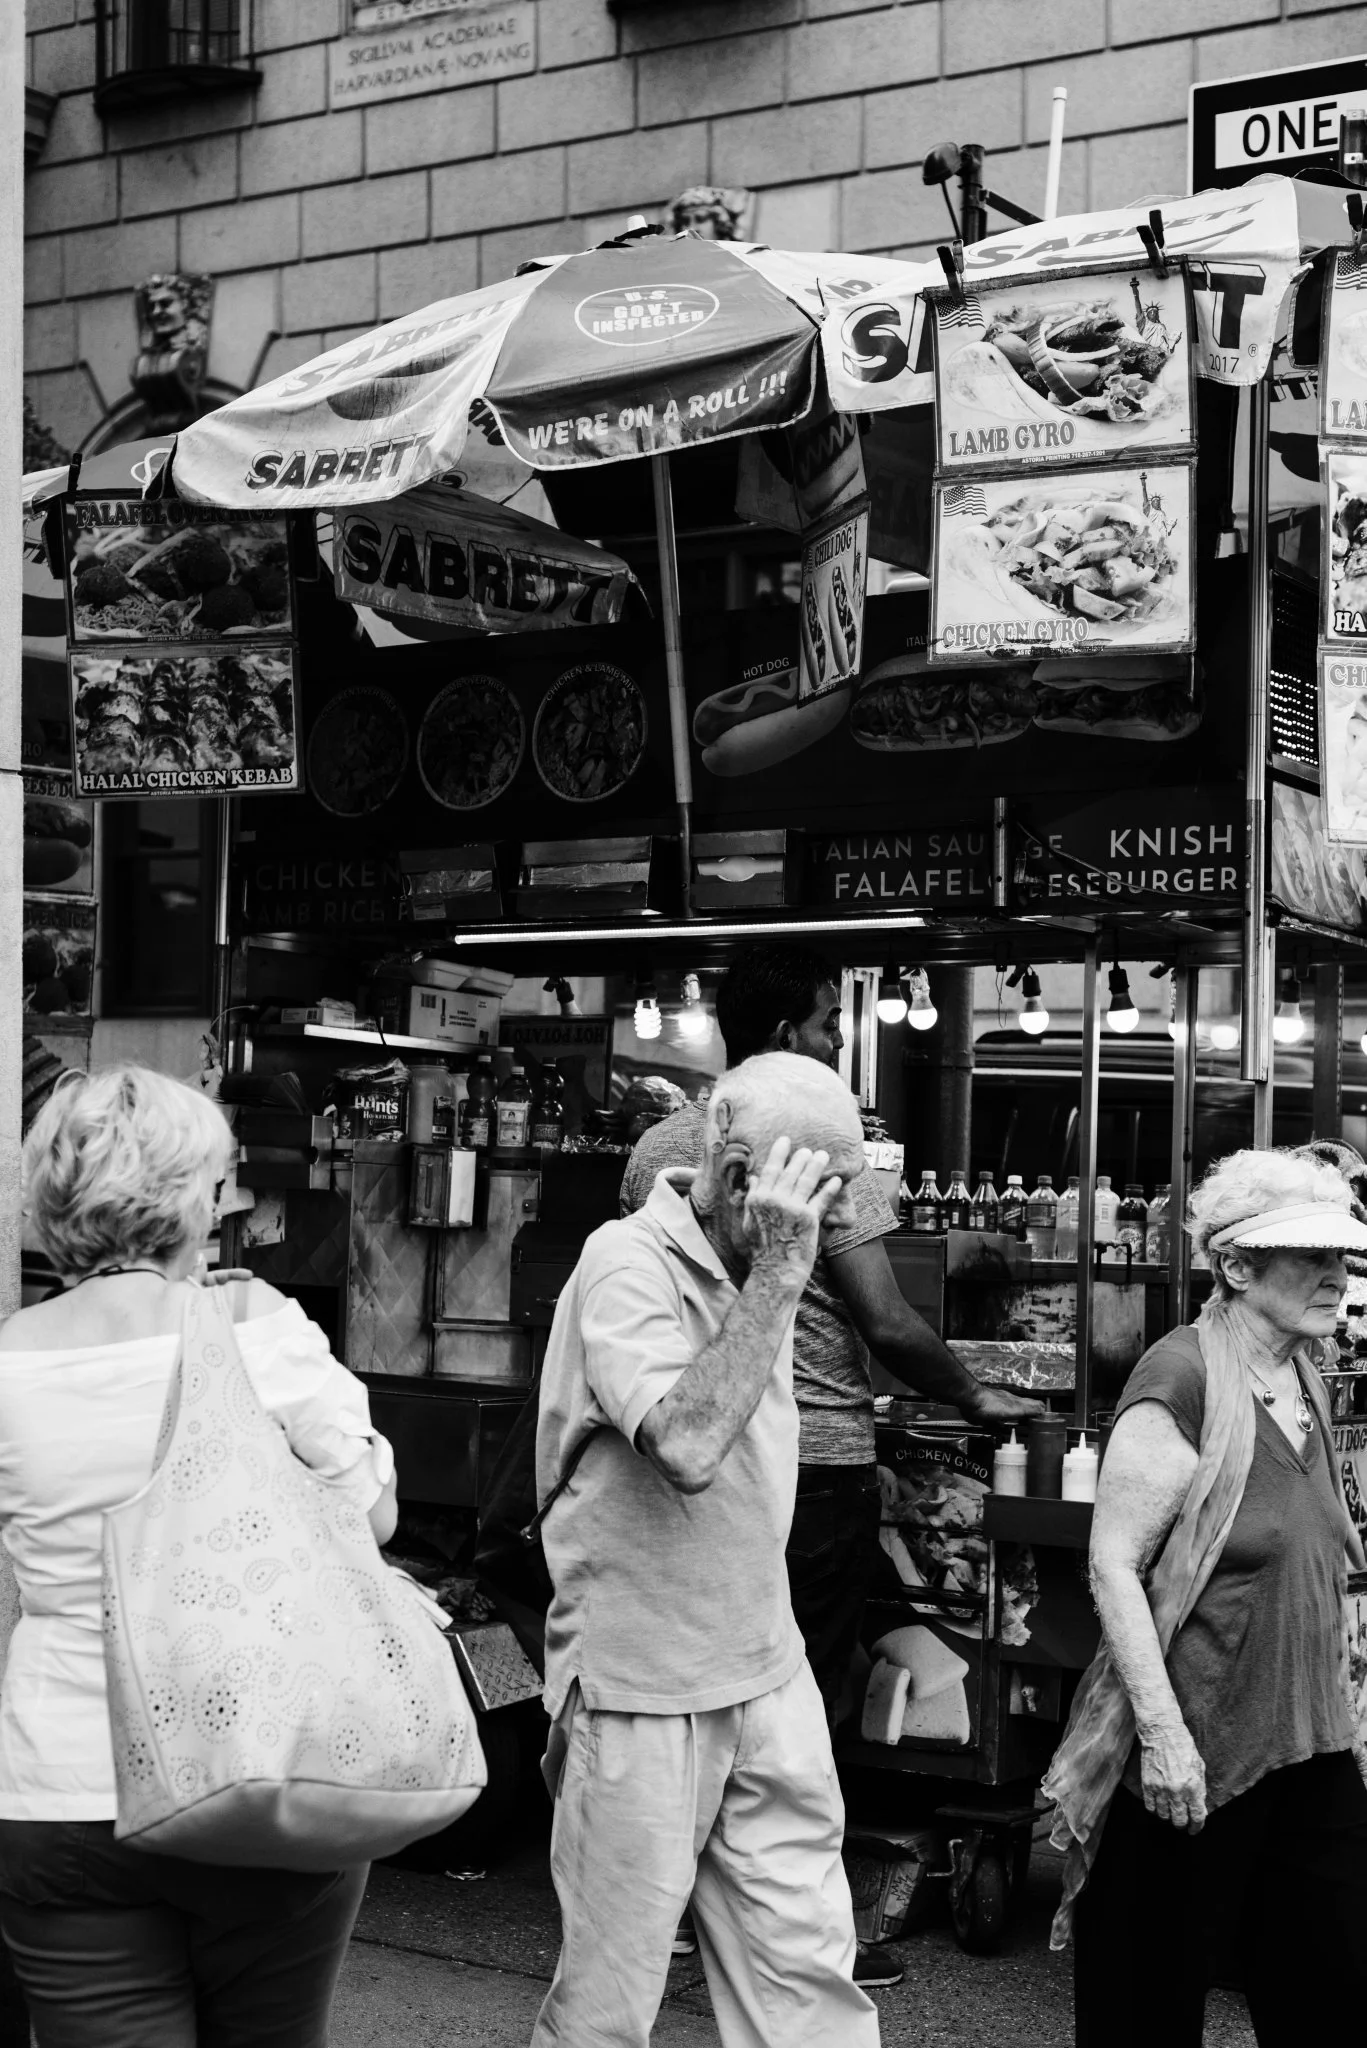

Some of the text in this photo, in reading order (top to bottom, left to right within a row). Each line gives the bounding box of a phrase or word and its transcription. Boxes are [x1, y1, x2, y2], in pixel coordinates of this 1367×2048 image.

[423, 18, 516, 51] ACADEMIAE
[1242, 101, 1339, 158] ONE
[966, 198, 1264, 269] SABETT
[614, 302, 682, 319] GOV'T
[625, 290, 669, 302] U.S.
[593, 310, 704, 335] INSPECTED
[1209, 353, 1240, 374] 2017
[528, 412, 609, 451] WE'RE
[618, 403, 654, 432] ON
[663, 400, 680, 424] A
[688, 385, 750, 419] ROLL
[1331, 400, 1367, 430] LA
[950, 420, 1075, 456] LAMB GYRO
[1021, 456, 1044, 464] ASTORIA
[1045, 453, 1071, 461] PRINTING
[74, 501, 166, 529] FALAFEL
[814, 526, 852, 568] CHILI DOG
[342, 514, 615, 624] SABRETT
[943, 617, 1089, 648] CHICKEN GYRO
[546, 666, 582, 701] CHICKEN
[594, 663, 620, 678] LAMB
[620, 674, 637, 694] MIX
[742, 657, 790, 680] HOT DOG
[82, 767, 293, 790] HALAL CHICKEN KEBAB
[928, 834, 1064, 860] SAUGE
[1109, 824, 1233, 859] KNISH
[255, 859, 400, 892] CHICKEN
[834, 868, 984, 898] FALAFEL
[257, 901, 312, 926] AMB
[895, 1449, 989, 1480] CHICKEN GYRO
